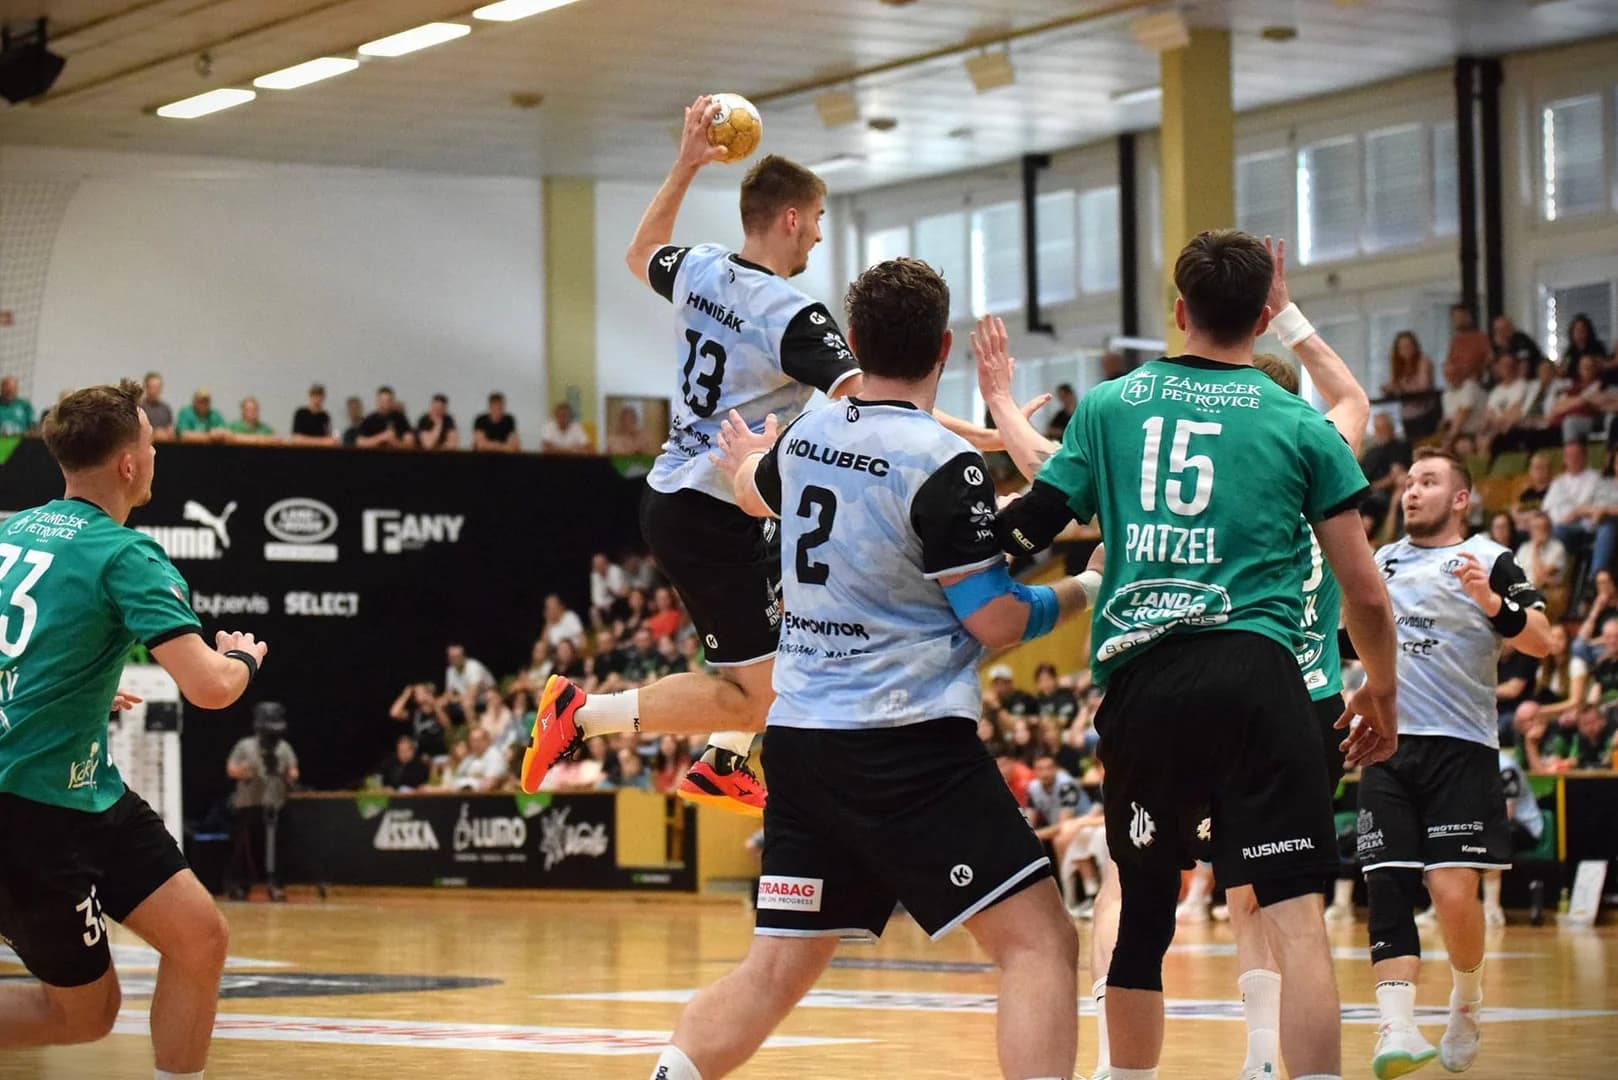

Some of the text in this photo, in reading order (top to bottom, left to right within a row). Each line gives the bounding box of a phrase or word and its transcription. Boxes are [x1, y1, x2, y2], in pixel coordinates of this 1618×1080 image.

[686, 292, 746, 333] HNIĎÁK
[682, 328, 727, 418] 13
[1162, 375, 1262, 395] ZÁMEČEK
[1160, 388, 1260, 409] PETROVICE
[786, 439, 890, 478] HOLUBEC
[1140, 416, 1223, 516] 15
[135, 526, 215, 559] UMA
[796, 485, 837, 586] 2
[1126, 523, 1223, 565] PATZEL
[284, 592, 360, 617] SELECT
[1130, 592, 1191, 609] LAND
[1133, 603, 1206, 621] ROVER
[1242, 837, 1315, 859] PLUSMETAL
